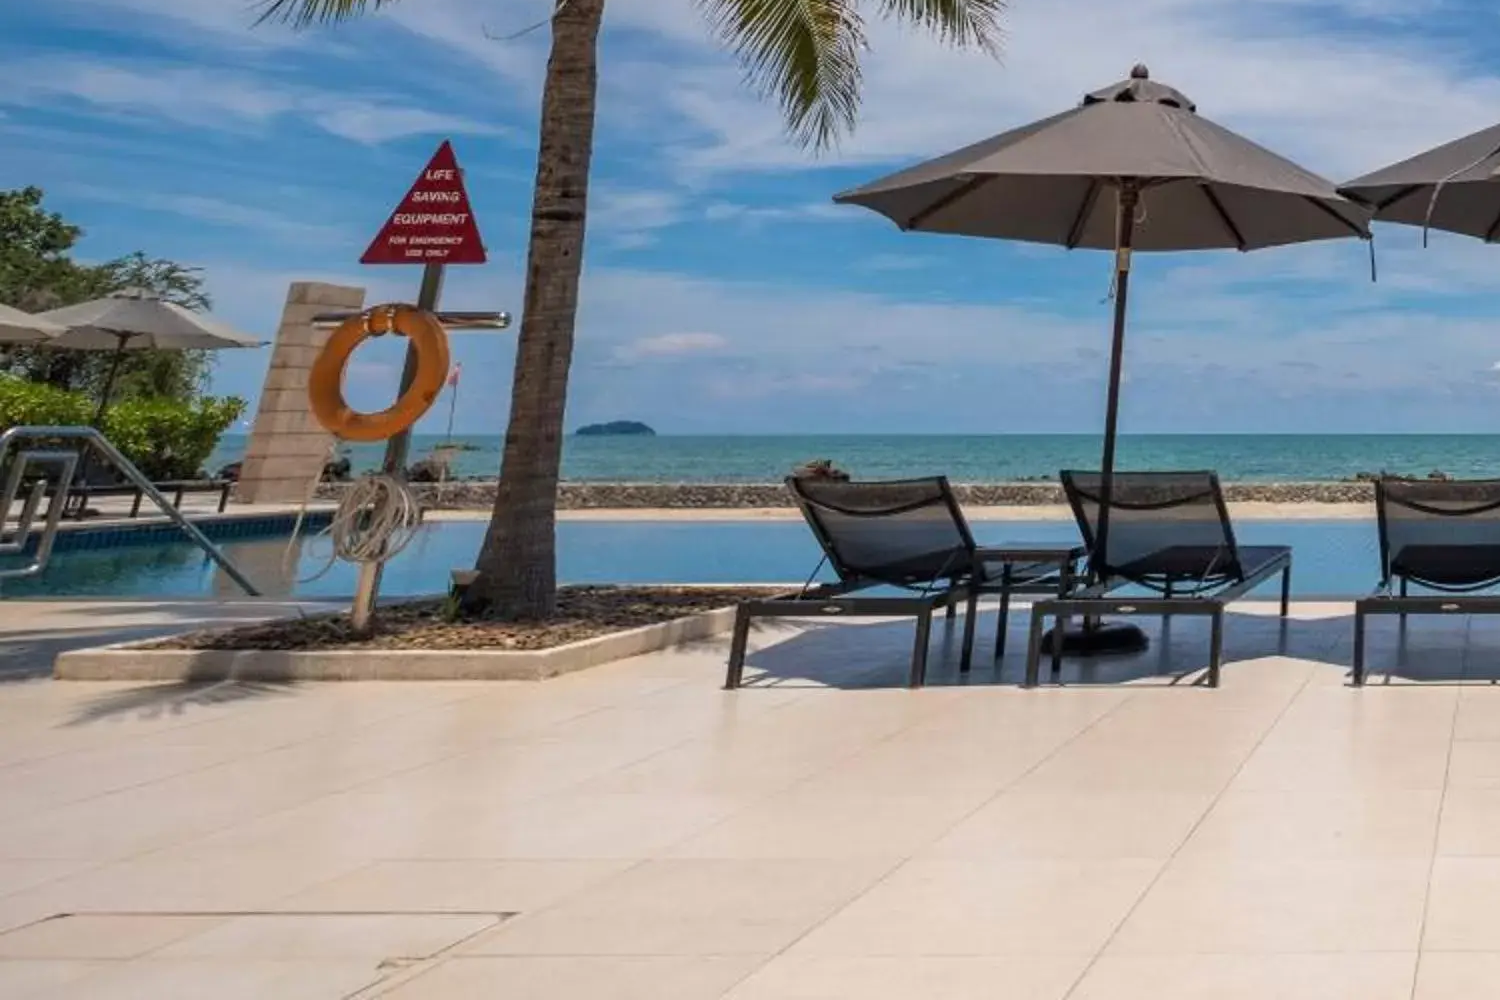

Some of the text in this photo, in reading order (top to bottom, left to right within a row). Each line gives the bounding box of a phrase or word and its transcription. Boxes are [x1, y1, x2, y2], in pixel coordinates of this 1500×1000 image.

[425, 169, 454, 181] LIFE
[412, 191, 460, 202] SAVING
[393, 213, 468, 225] EQUIPMENT
[389, 236, 407, 245] FOR
